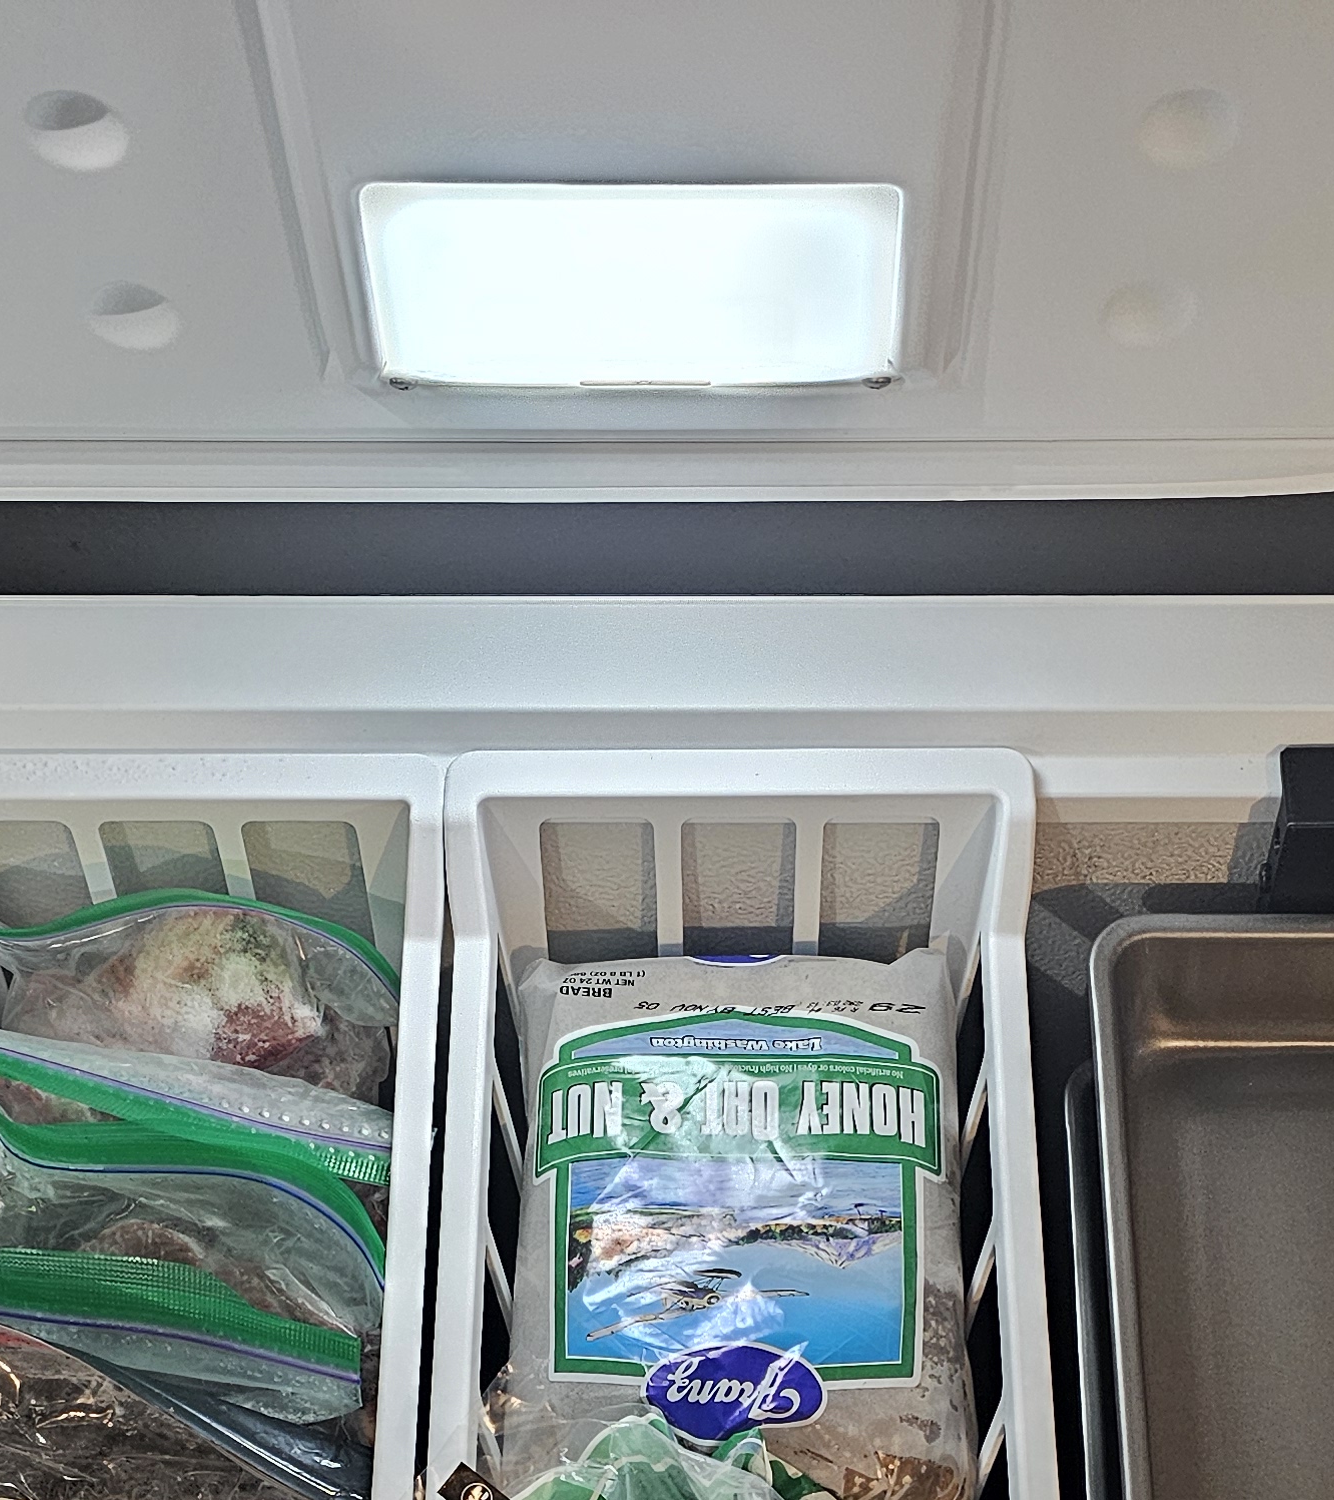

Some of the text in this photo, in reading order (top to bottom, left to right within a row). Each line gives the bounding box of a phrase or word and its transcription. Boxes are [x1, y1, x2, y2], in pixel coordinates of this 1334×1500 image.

[580, 977, 593, 985] 24
[559, 986, 612, 998] BREAD
[634, 1001, 660, 1010] 05
[742, 1004, 795, 1016] BEST
[868, 1003, 926, 1014] 29
[650, 1035, 822, 1051] Lake Washington
[760, 1063, 780, 1073] high
[798, 1063, 817, 1073] dyes
[829, 1065, 854, 1074] colors
[856, 1067, 891, 1077] artificial
[891, 1070, 903, 1078] No
[546, 1080, 926, 1147] HONEY OAT & NUT
[666, 1358, 800, 1420] Franz
